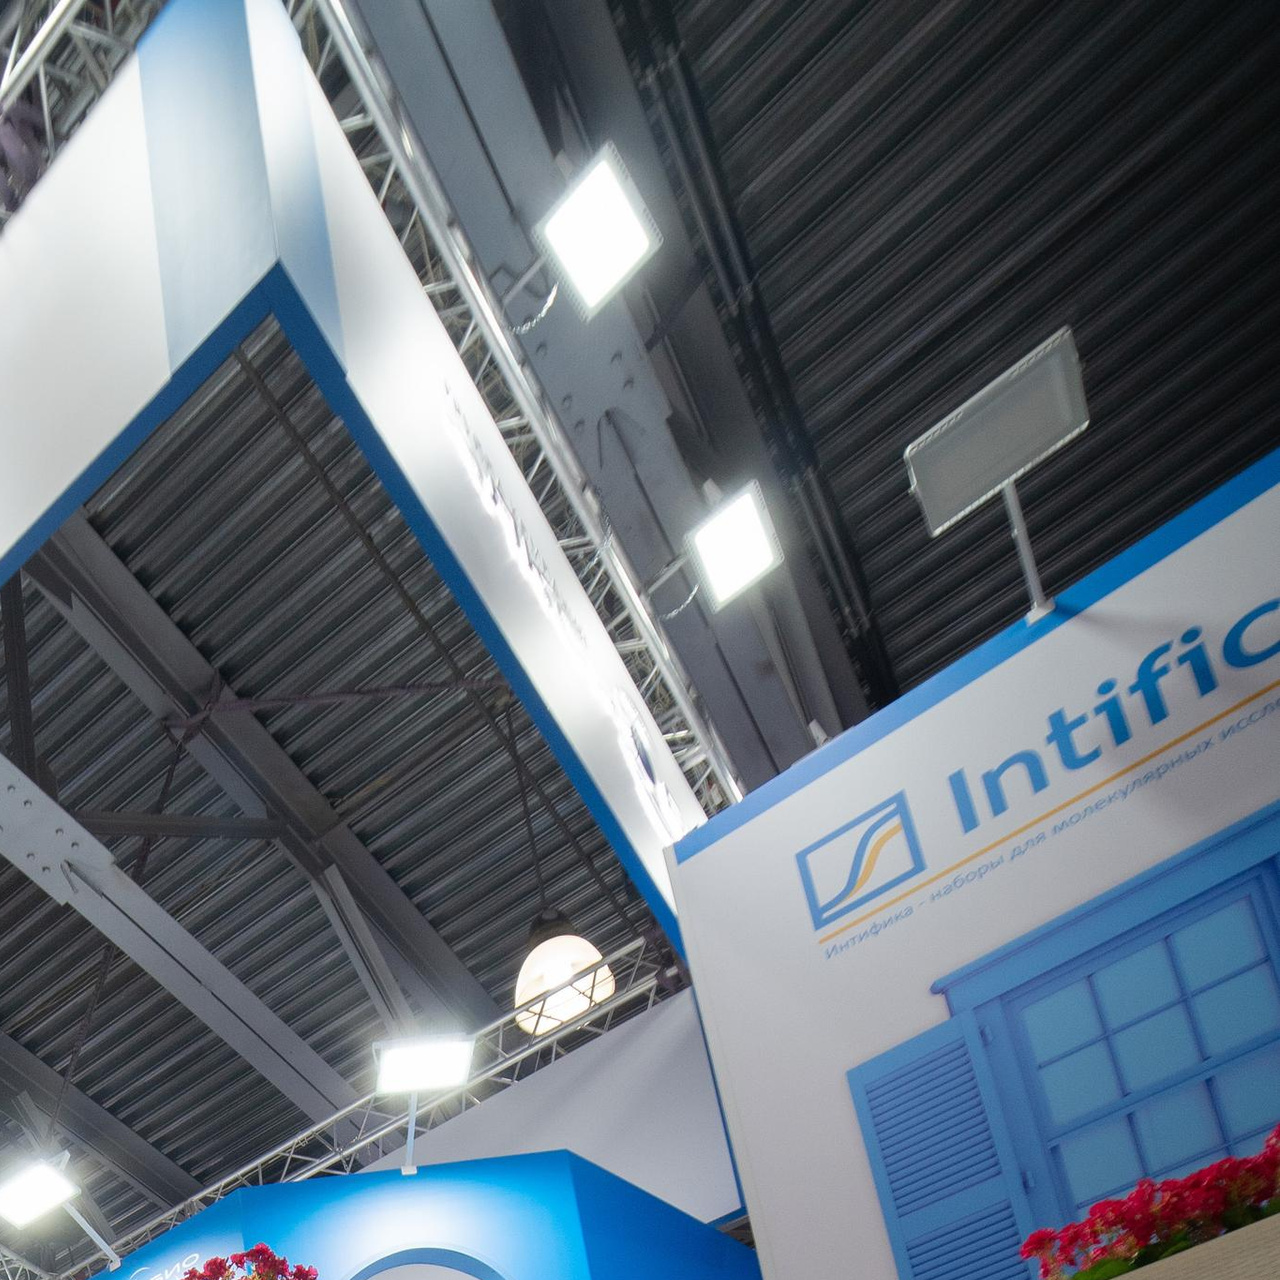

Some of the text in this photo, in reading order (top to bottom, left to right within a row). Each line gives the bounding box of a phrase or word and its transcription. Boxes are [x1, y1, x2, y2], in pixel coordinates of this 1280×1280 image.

[824, 905, 914, 960] Интифика
[930, 853, 1005, 903] наборы
[1008, 829, 1047, 862] для
[1050, 736, 1215, 837] молекулярных
[1219, 697, 1280, 743] иссл
